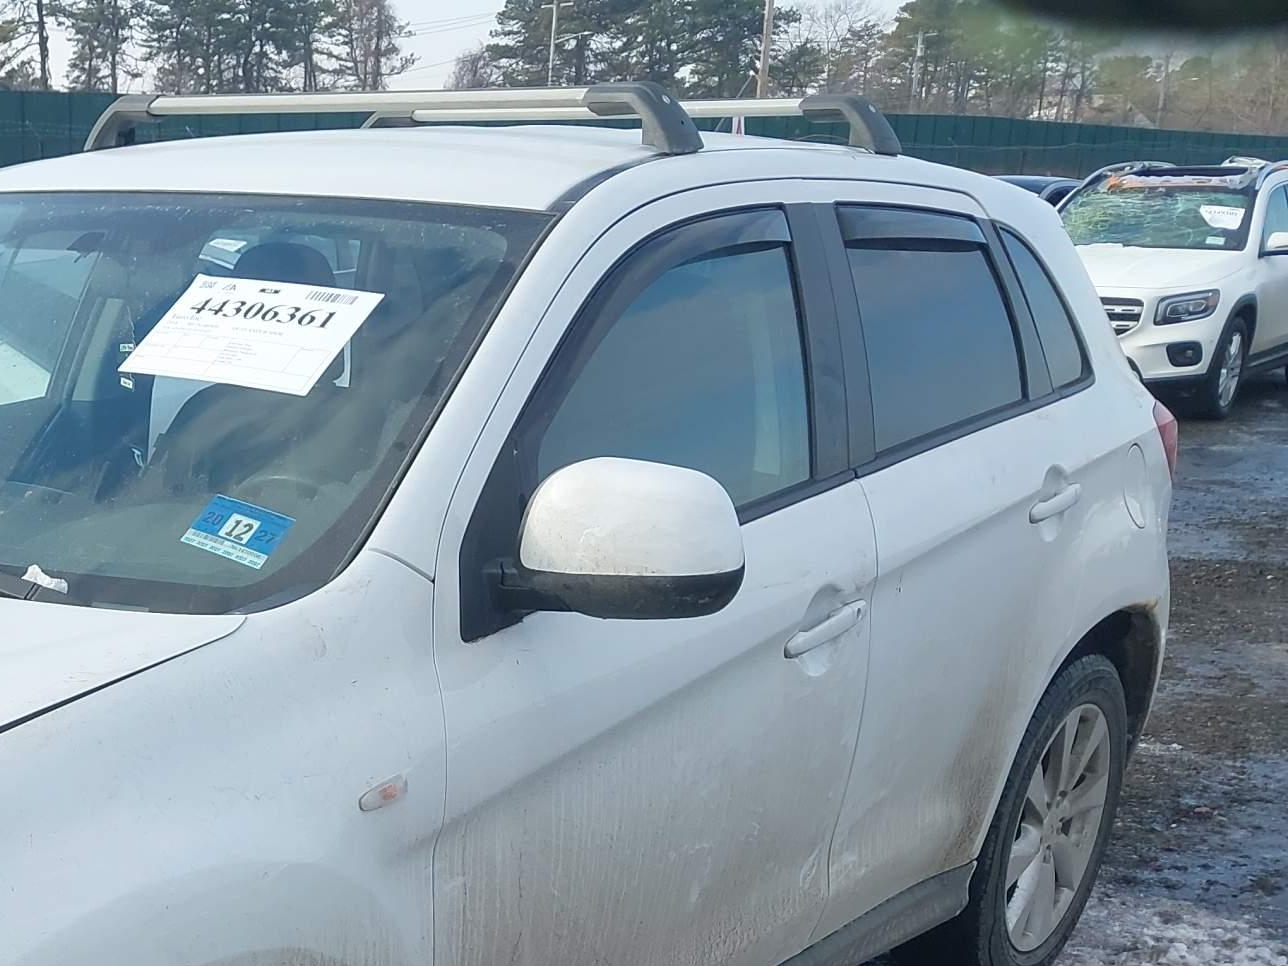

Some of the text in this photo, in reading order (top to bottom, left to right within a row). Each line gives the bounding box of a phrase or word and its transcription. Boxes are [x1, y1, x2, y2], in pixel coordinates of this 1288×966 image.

[189, 297, 338, 329] 44306361
[225, 519, 254, 542] 12
[255, 529, 276, 544] 27
